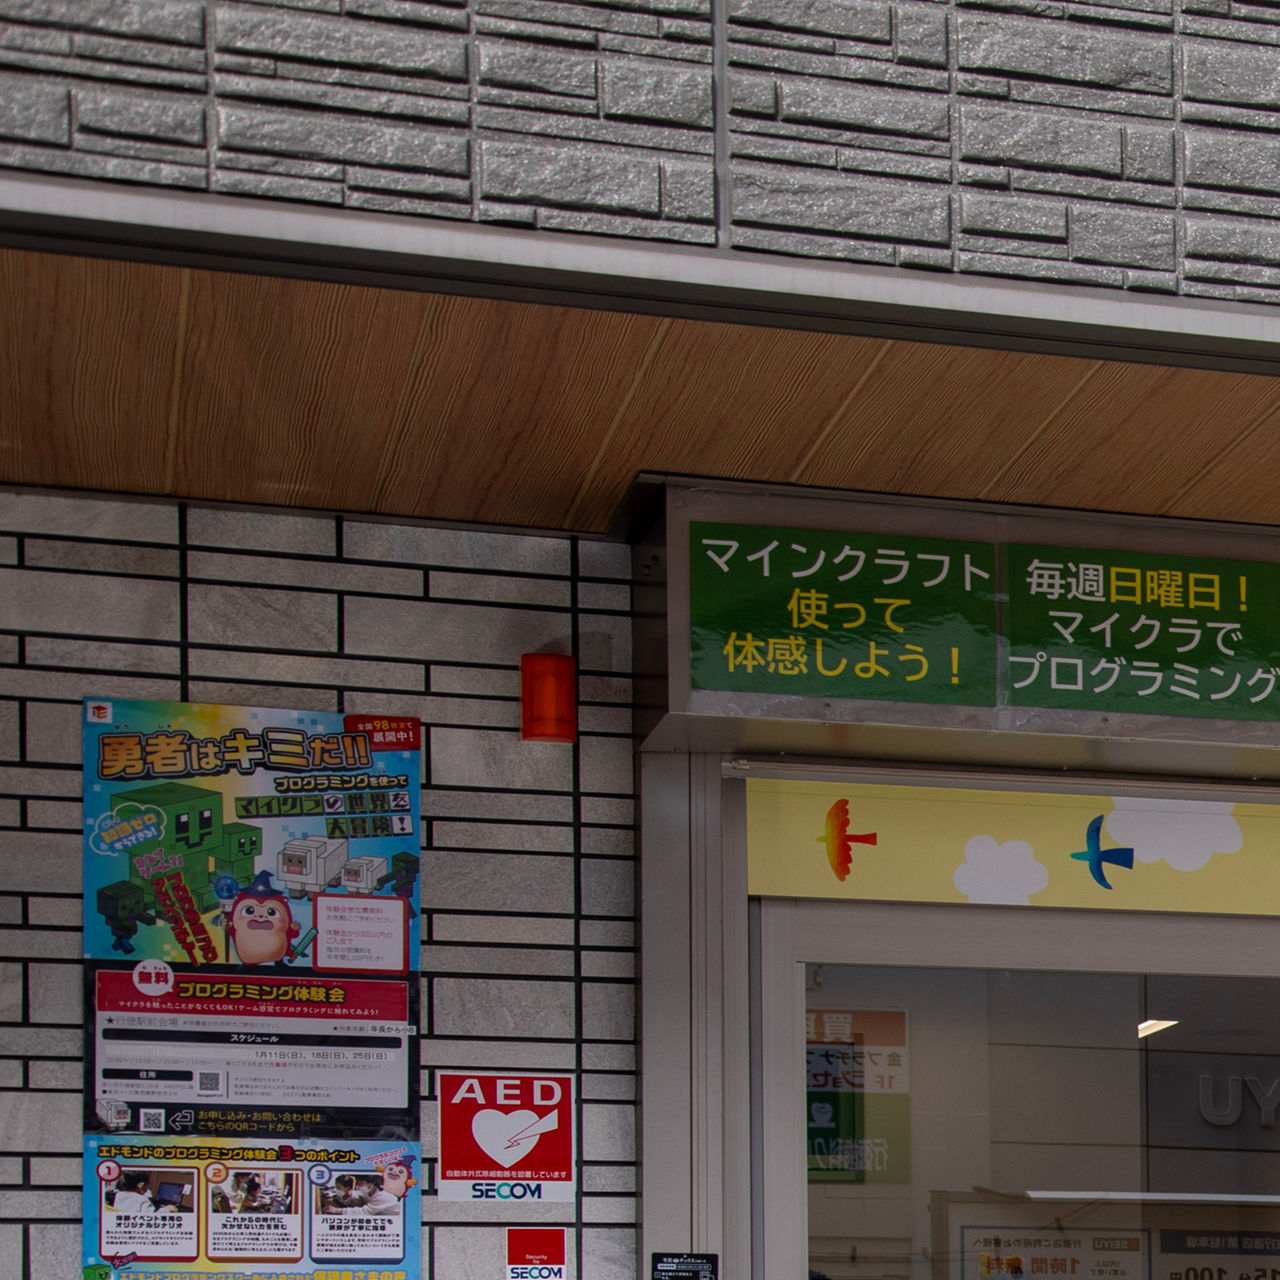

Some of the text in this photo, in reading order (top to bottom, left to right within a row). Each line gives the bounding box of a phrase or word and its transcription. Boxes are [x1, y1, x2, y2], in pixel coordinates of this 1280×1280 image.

[701, 538, 990, 591] マインクラフト
[1026, 559, 1248, 612] 毎週日曜日!
[787, 588, 911, 633] 使って
[1049, 610, 1243, 655] マイクラで
[723, 632, 959, 685] 体感しよう!
[1009, 651, 1280, 702] プログラミング
[179, 982, 346, 1003] プログラミング体験会
[230, 1034, 279, 1044] スケジュール
[451, 1079, 562, 1106] AED
[446, 1169, 567, 1180] 自動体外式除細動器を設置しています
[472, 1182, 542, 1199] SECOM
[510, 1266, 563, 1280] SECOM
